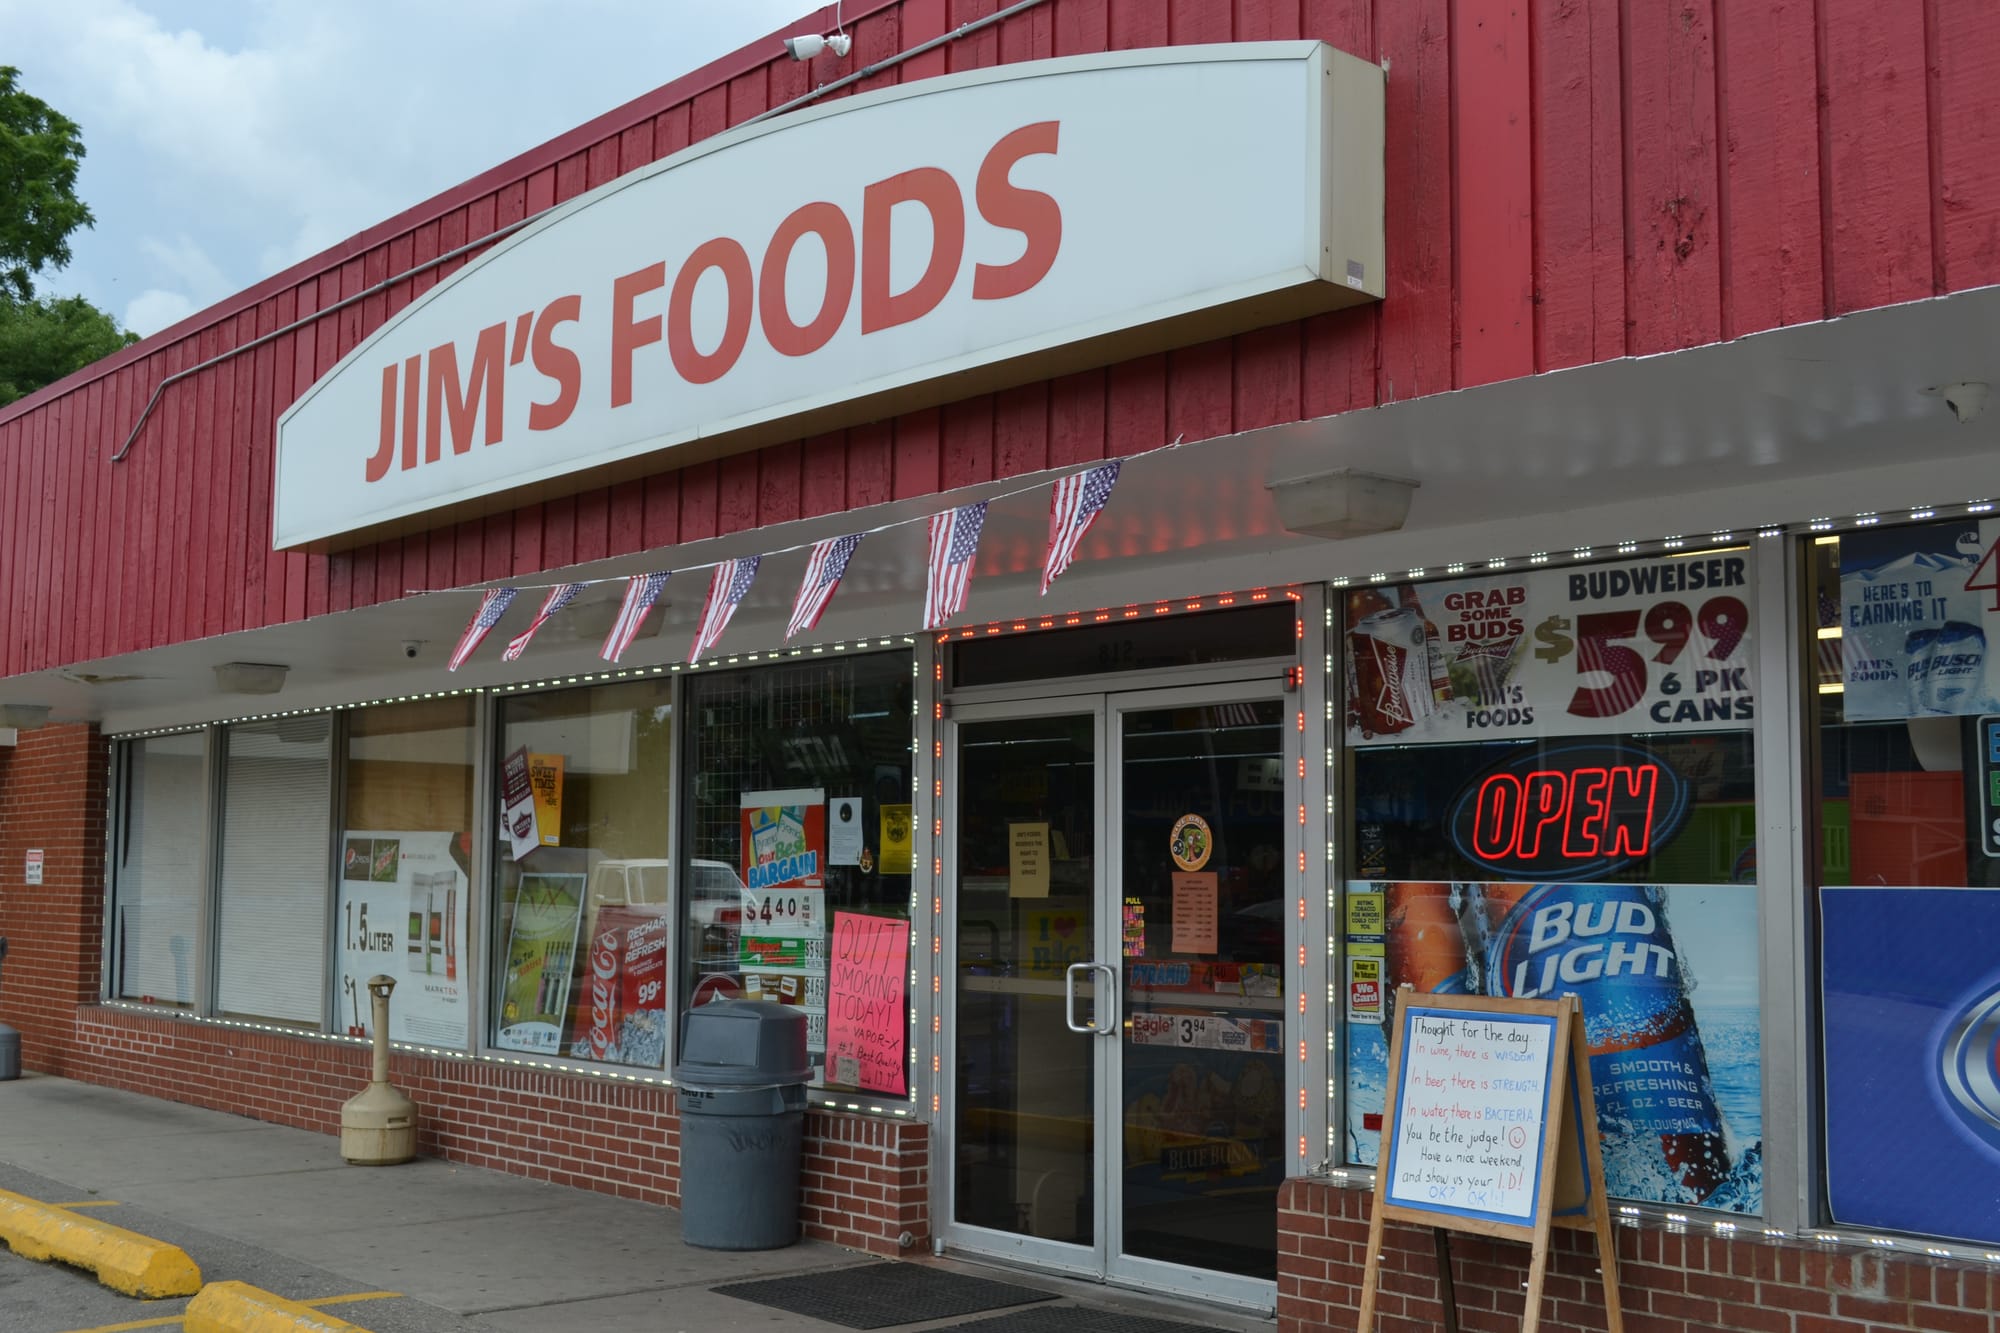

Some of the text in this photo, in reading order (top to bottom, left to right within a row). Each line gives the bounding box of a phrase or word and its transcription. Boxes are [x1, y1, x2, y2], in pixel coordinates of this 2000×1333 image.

[365, 120, 1063, 483] JIM'S FOODS
[1569, 557, 1746, 601] BUDWEISER
[1444, 587, 1526, 611] GRAB
[1863, 580, 1932, 602] HERE'S TO
[1460, 607, 1512, 622] SOME
[1850, 598, 1947, 628] EARNING IT
[1448, 619, 1525, 642] BUDS
[1854, 658, 1894, 671] JIM'S
[1931, 654, 1982, 670] BUSCH
[1938, 667, 1973, 675] LIGHT
[1660, 667, 1748, 695] 6 PK
[1851, 669, 1899, 682] FOODS
[1476, 686, 1523, 706] JIM'S
[1466, 707, 1534, 728] FOODS
[1650, 696, 1754, 723] CANS
[1472, 764, 1659, 860] OPEN
[748, 850, 817, 889] BARGAIN
[1125, 897, 1141, 905] PULL
[345, 901, 368, 952] 1.5
[626, 916, 668, 942] RECHAR
[1528, 901, 1656, 955] BUD
[369, 932, 394, 952] LITER
[625, 938, 667, 964] REFRESH
[628, 936, 645, 950] AND
[838, 919, 905, 974] QUIT
[1130, 962, 1191, 985] PYRAMID
[1512, 942, 1674, 998] LIGHT
[424, 985, 458, 996] MARKTEN
[832, 963, 900, 1004] SMOKING
[1356, 983, 1374, 994] We
[1352, 993, 1378, 1003] Card
[835, 992, 893, 1032] TODAY!
[1134, 1016, 1170, 1036] Eagle
[1414, 1017, 1454, 1044] Thought
[1461, 1022, 1479, 1038] for
[1484, 1023, 1504, 1042] the
[853, 1027, 900, 1050] VAPOR-X
[856, 1045, 875, 1063] Best
[875, 1052, 902, 1076] Quality
[1415, 1041, 1535, 1062] In wine, there is WISDOM
[1610, 1060, 1695, 1075] SMOOTH &
[1411, 1067, 1421, 1085] In
[1425, 1069, 1447, 1094] beer,
[1451, 1072, 1476, 1090] there
[1480, 1075, 1489, 1090] is
[1406, 1102, 1417, 1119] In
[1421, 1104, 1449, 1124] water,
[1451, 1105, 1472, 1120] there
[1474, 1108, 1482, 1120] is
[1667, 1097, 1703, 1110] BEER
[1406, 1123, 1422, 1144] You
[1429, 1125, 1441, 1144] be
[1444, 1125, 1464, 1143] the
[1168, 1143, 1262, 1170] BLUE BUNNY
[1420, 1149, 1441, 1163] Have
[1456, 1151, 1475, 1164] nice
[1402, 1167, 1422, 1184] and
[1425, 1167, 1449, 1185] show
[1453, 1175, 1463, 1185] us
[1468, 1176, 1494, 1189] your
[1428, 1185, 1456, 1201] OK?
